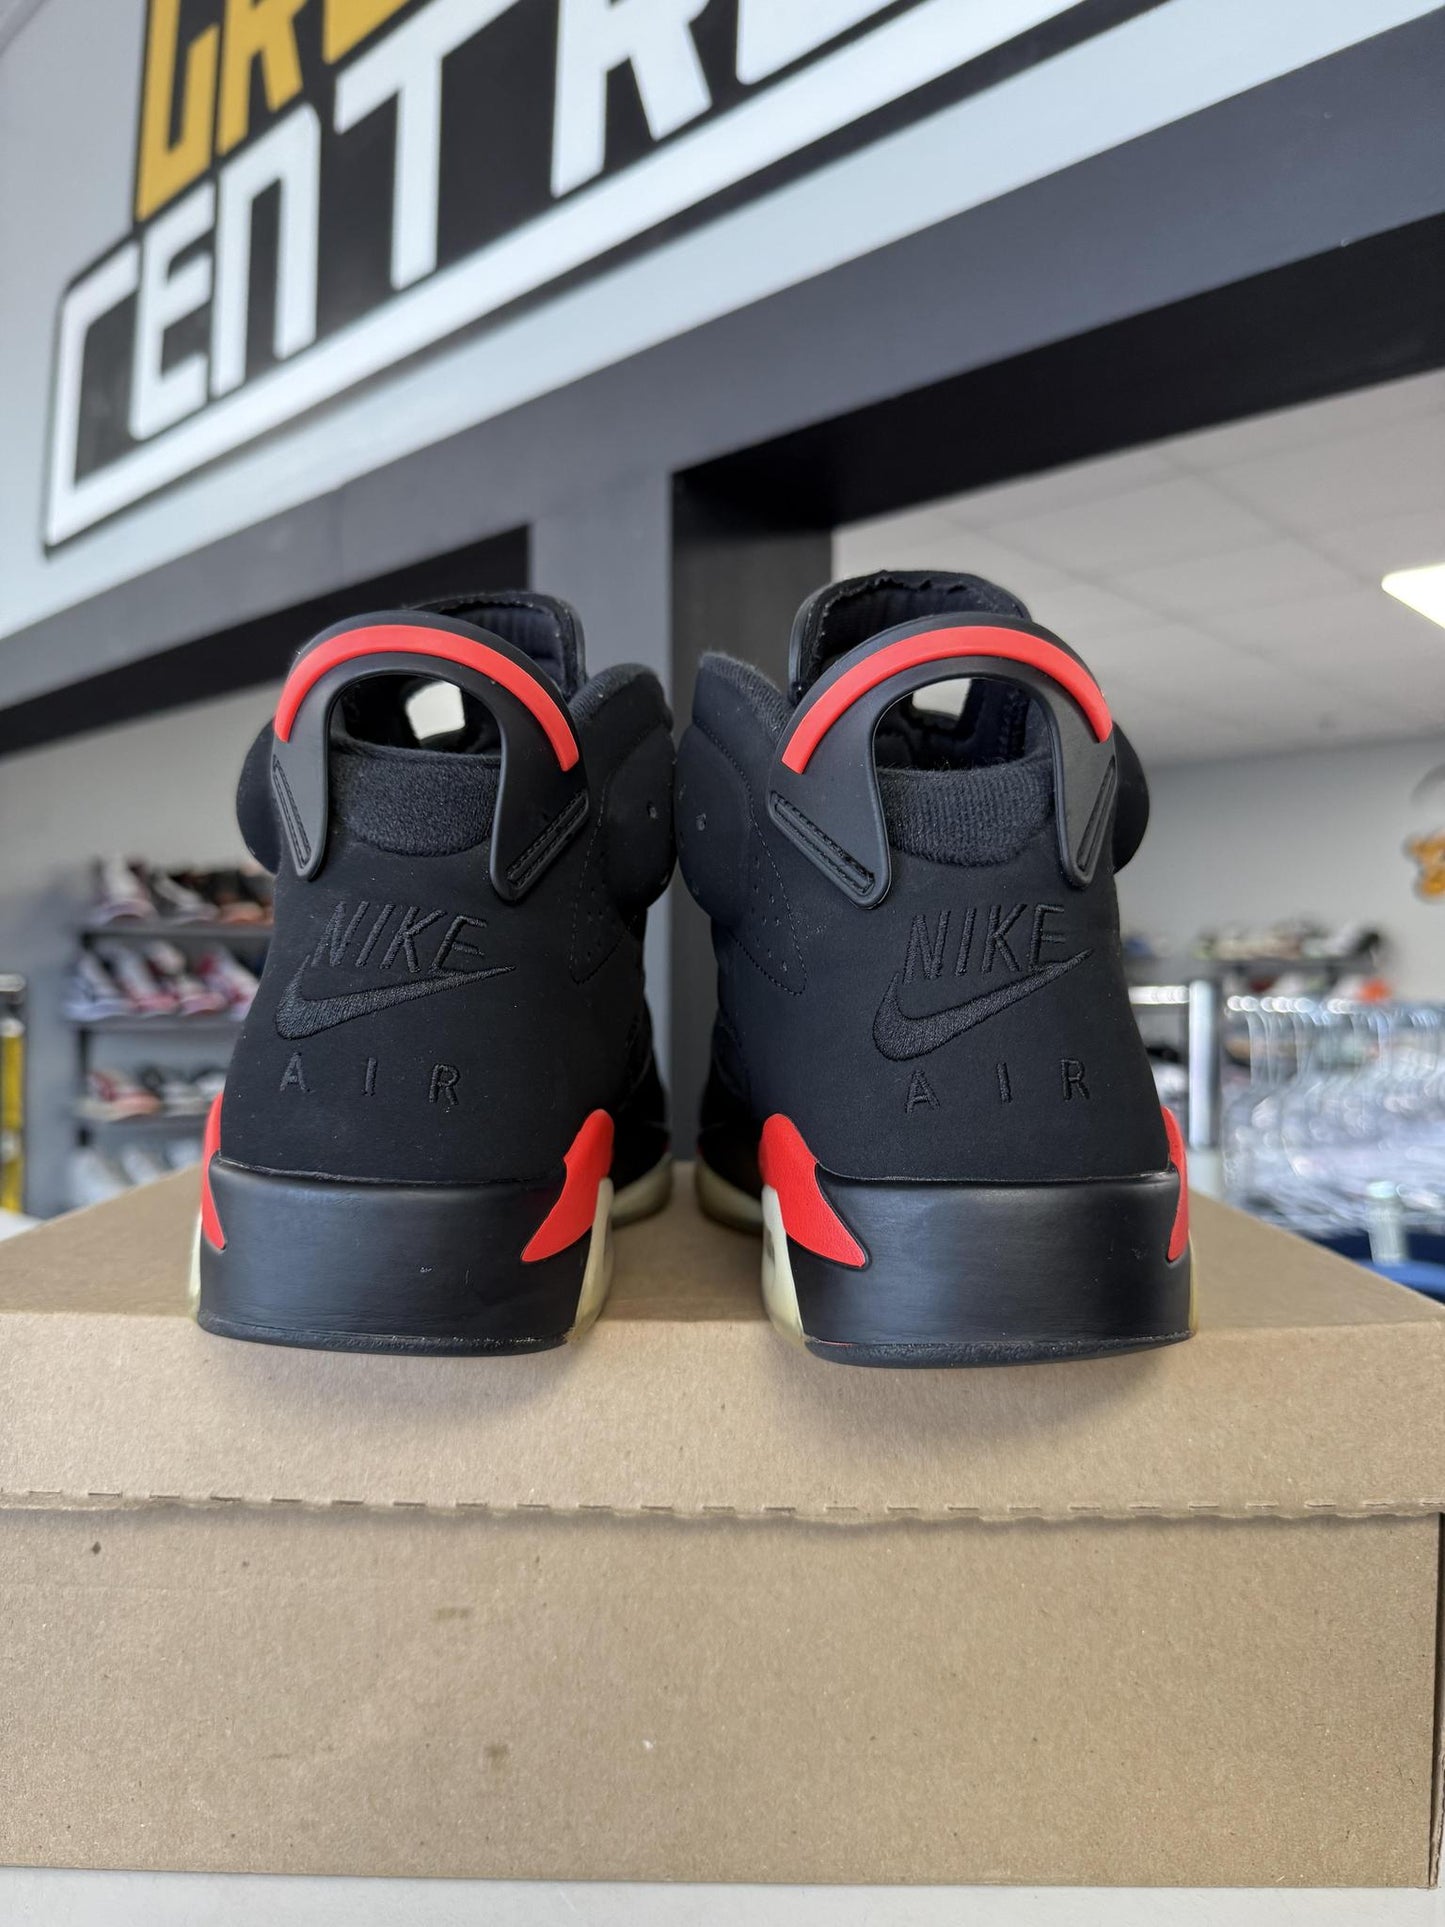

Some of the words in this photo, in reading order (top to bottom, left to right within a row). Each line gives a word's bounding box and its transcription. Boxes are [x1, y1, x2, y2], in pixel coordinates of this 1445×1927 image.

[134, 0, 410, 222] CR
[310, 900, 488, 977] NIKE
[902, 903, 1067, 985] NIKE
[279, 1051, 461, 1106] AIR
[904, 1058, 1090, 1114] AIR
